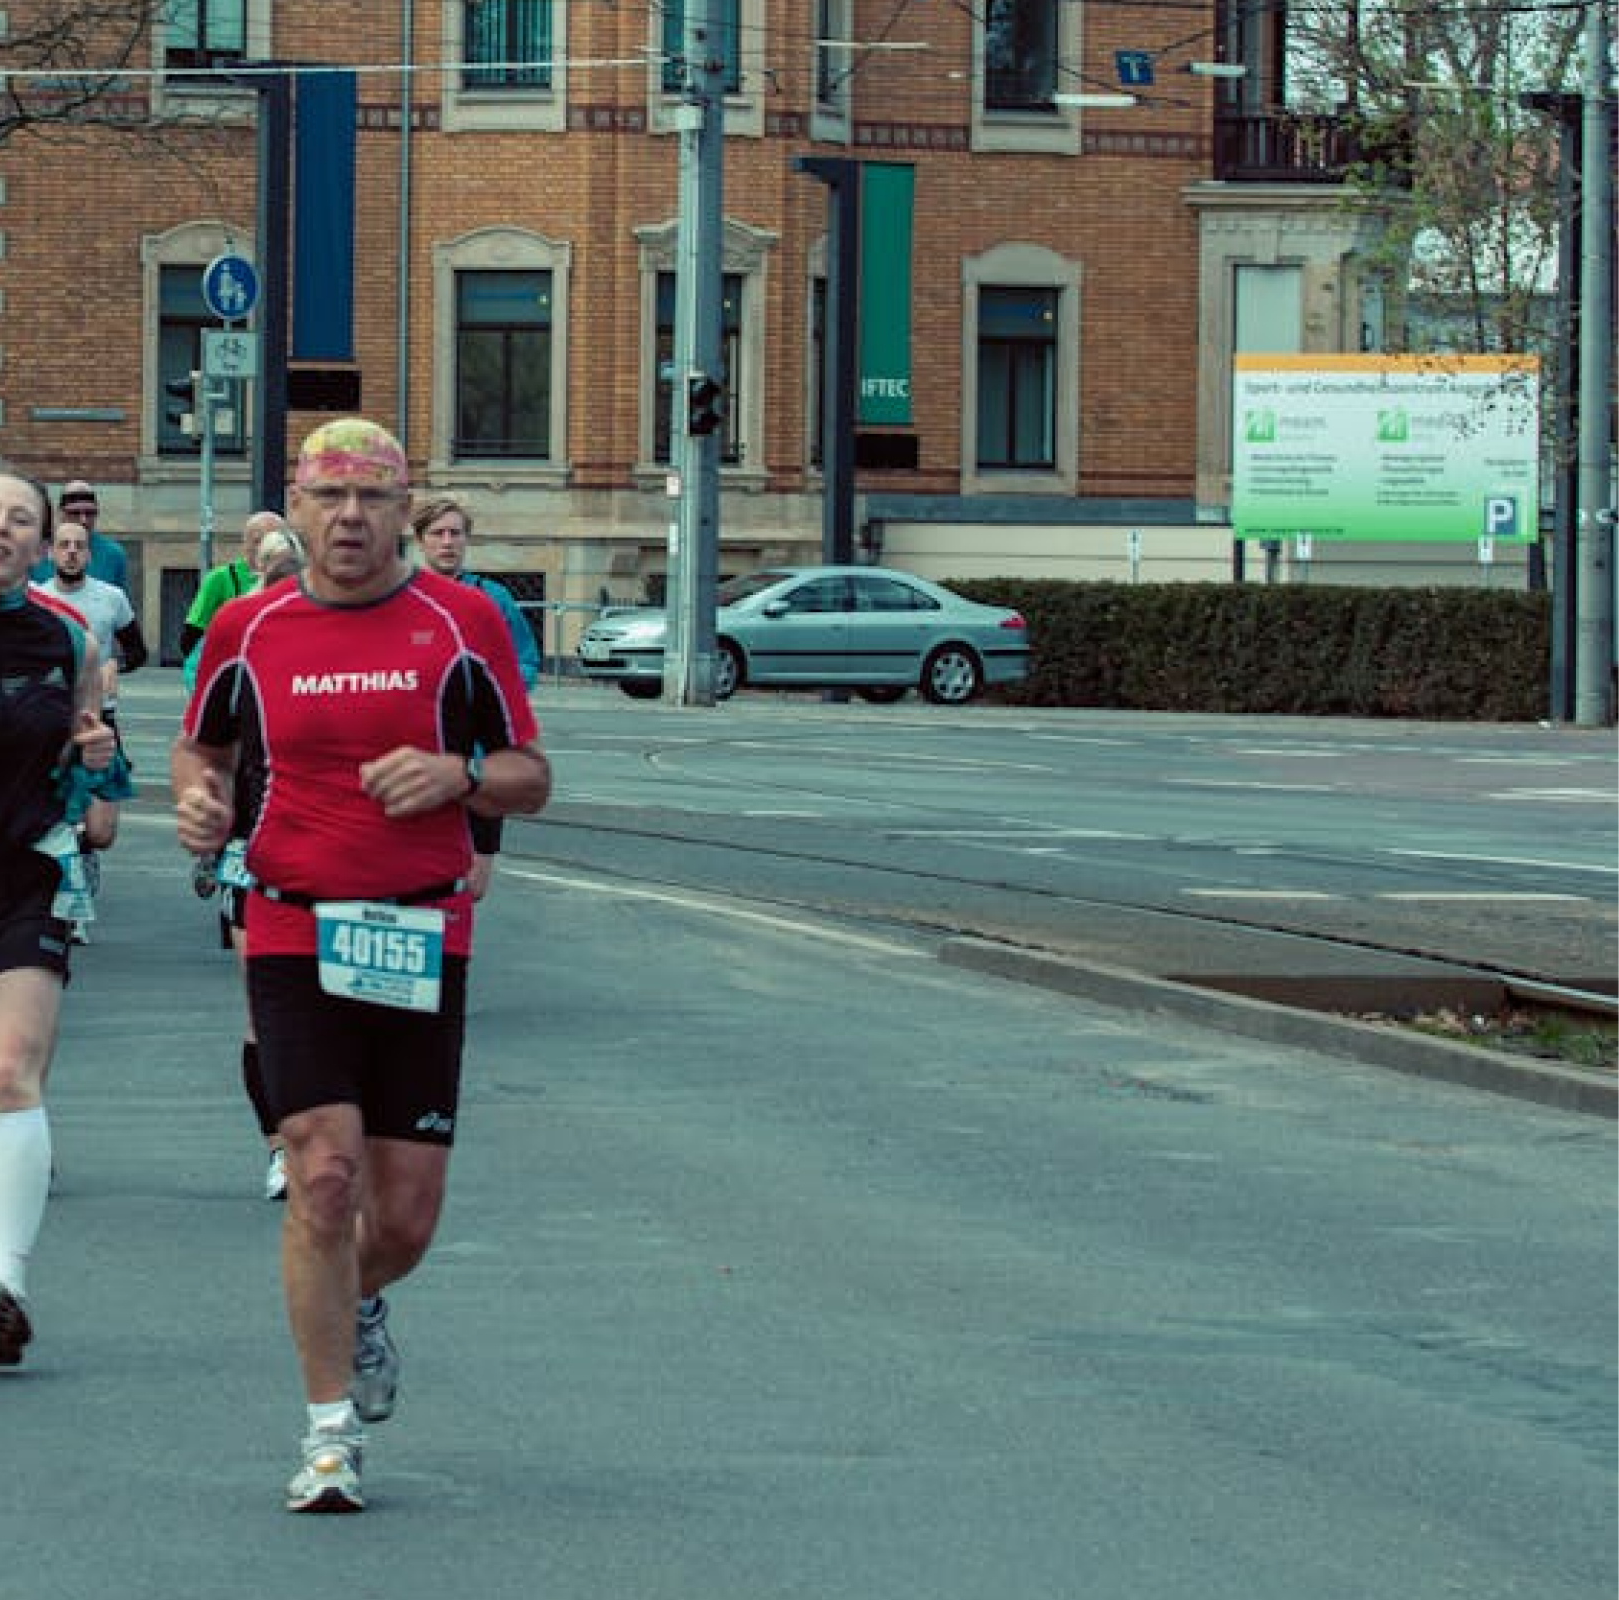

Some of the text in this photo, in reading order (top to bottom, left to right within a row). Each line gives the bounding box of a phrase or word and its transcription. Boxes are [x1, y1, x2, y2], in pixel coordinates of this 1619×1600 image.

[1121, 56, 1143, 81] T
[861, 378, 909, 397] IFTEC
[1487, 499, 1514, 533] P
[292, 669, 418, 695] MATTHIAS
[332, 923, 426, 973] 40155
